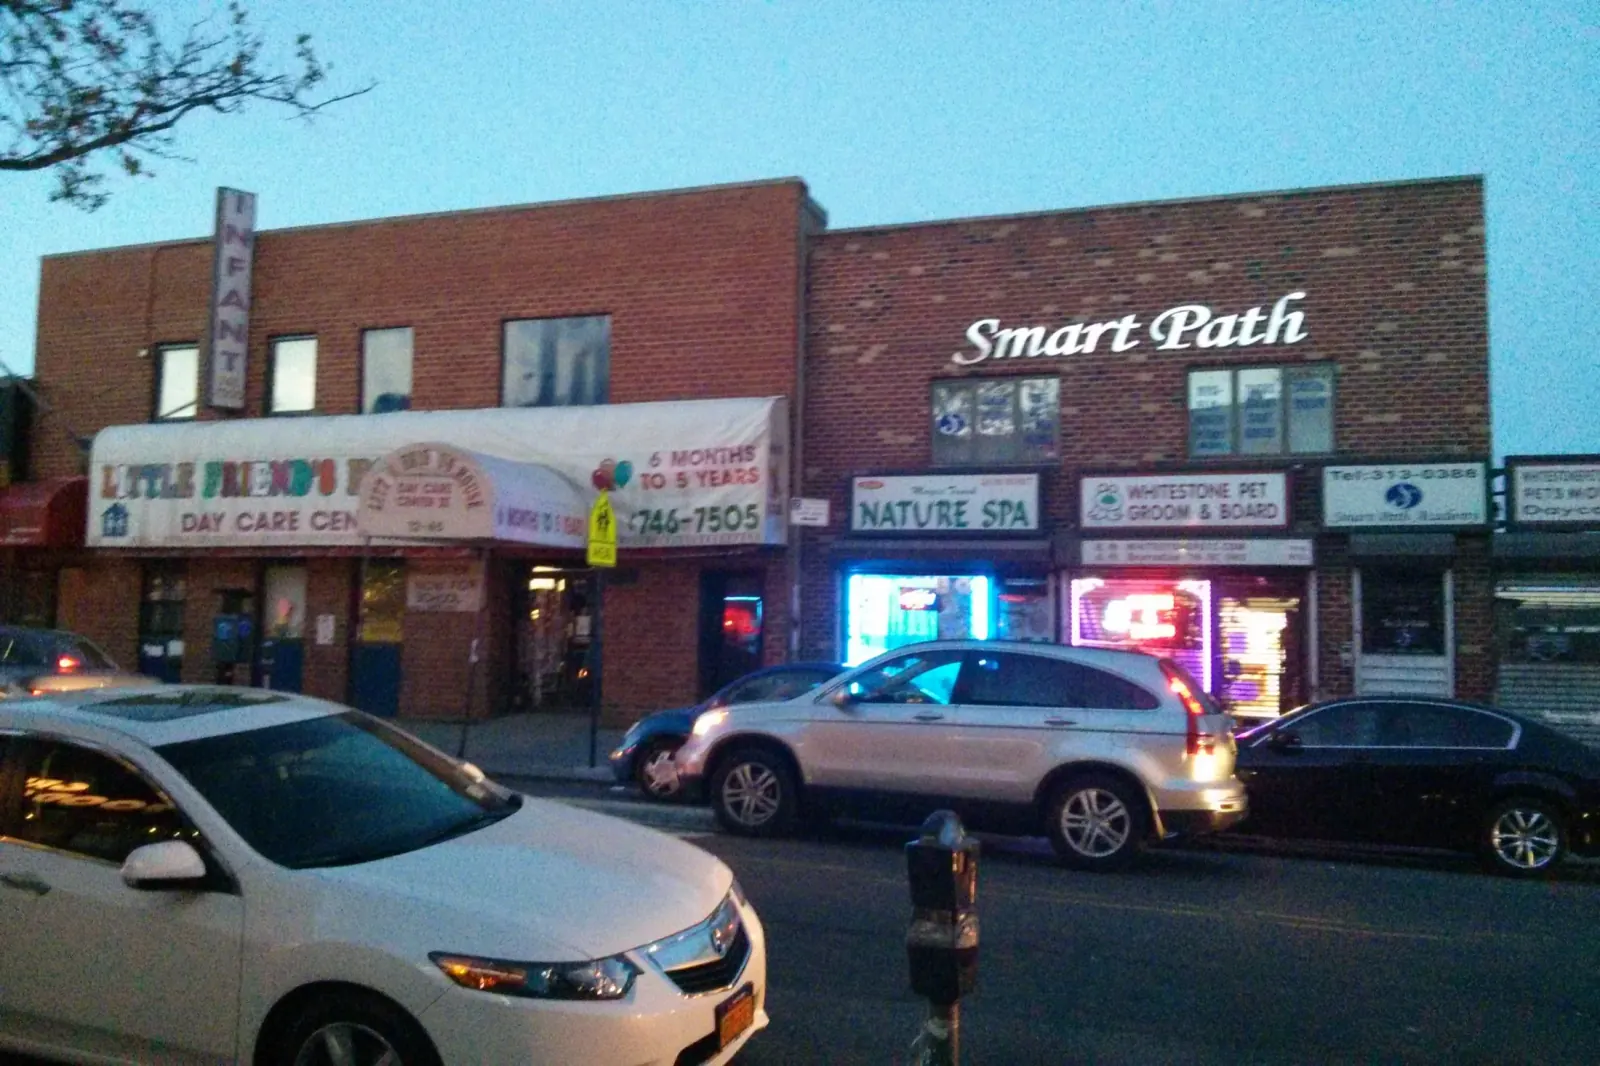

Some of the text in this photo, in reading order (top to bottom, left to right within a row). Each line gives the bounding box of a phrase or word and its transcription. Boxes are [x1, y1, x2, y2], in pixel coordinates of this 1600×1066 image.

[219, 194, 250, 371] INFANT
[952, 292, 1309, 365] Smart Path
[649, 444, 757, 467] 6 MONTHS
[102, 462, 195, 499] LITTLE
[640, 467, 760, 490] TO 5 YEARS
[1127, 482, 1268, 499] WHITESTONE PET
[181, 511, 225, 533] DAY
[236, 509, 300, 533] CARE
[859, 499, 1029, 528] NATURE SPA
[1127, 503, 1278, 521] GROOM & BOARD
